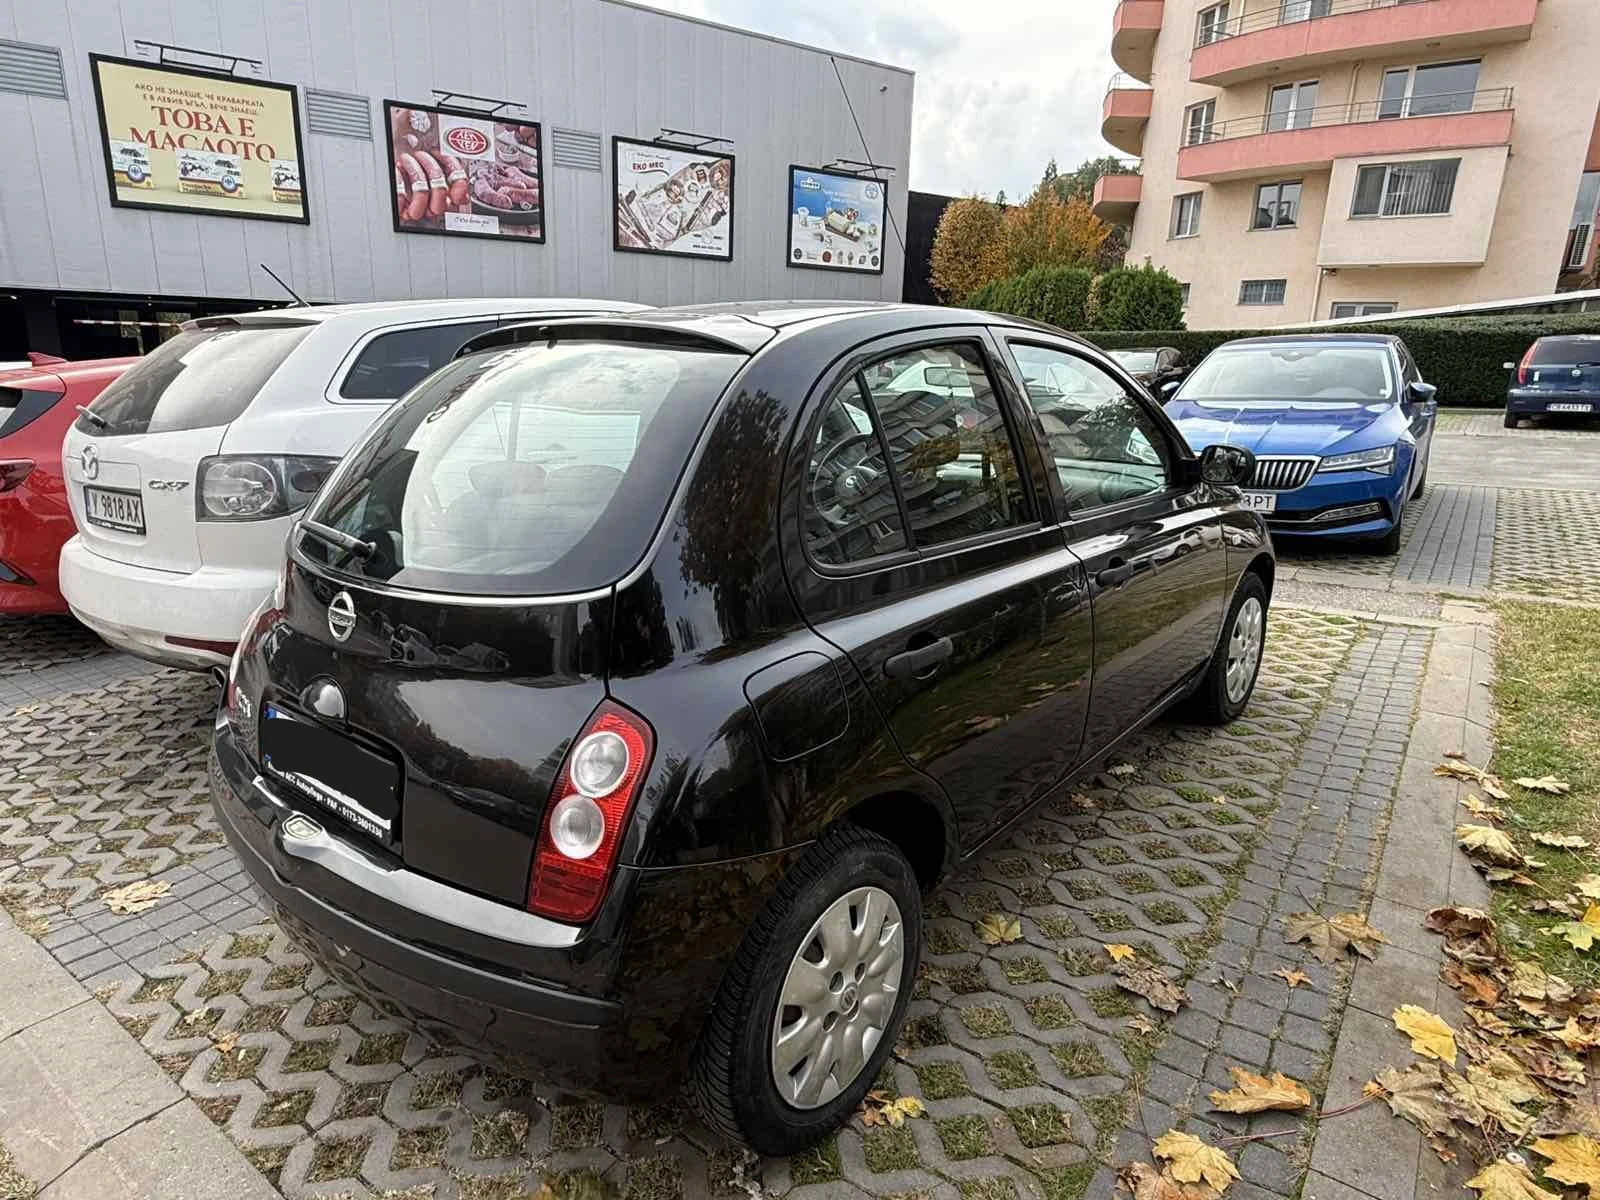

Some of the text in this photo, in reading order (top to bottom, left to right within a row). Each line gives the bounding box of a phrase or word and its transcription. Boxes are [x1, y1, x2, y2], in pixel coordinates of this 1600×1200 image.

[135, 83, 153, 93] АКО
[155, 86, 166, 94] НЕ
[151, 105, 256, 138] ТОВА Е
[101, 495, 125, 520] 9818
[126, 499, 141, 524] AX
[1254, 496, 1272, 508] PT
